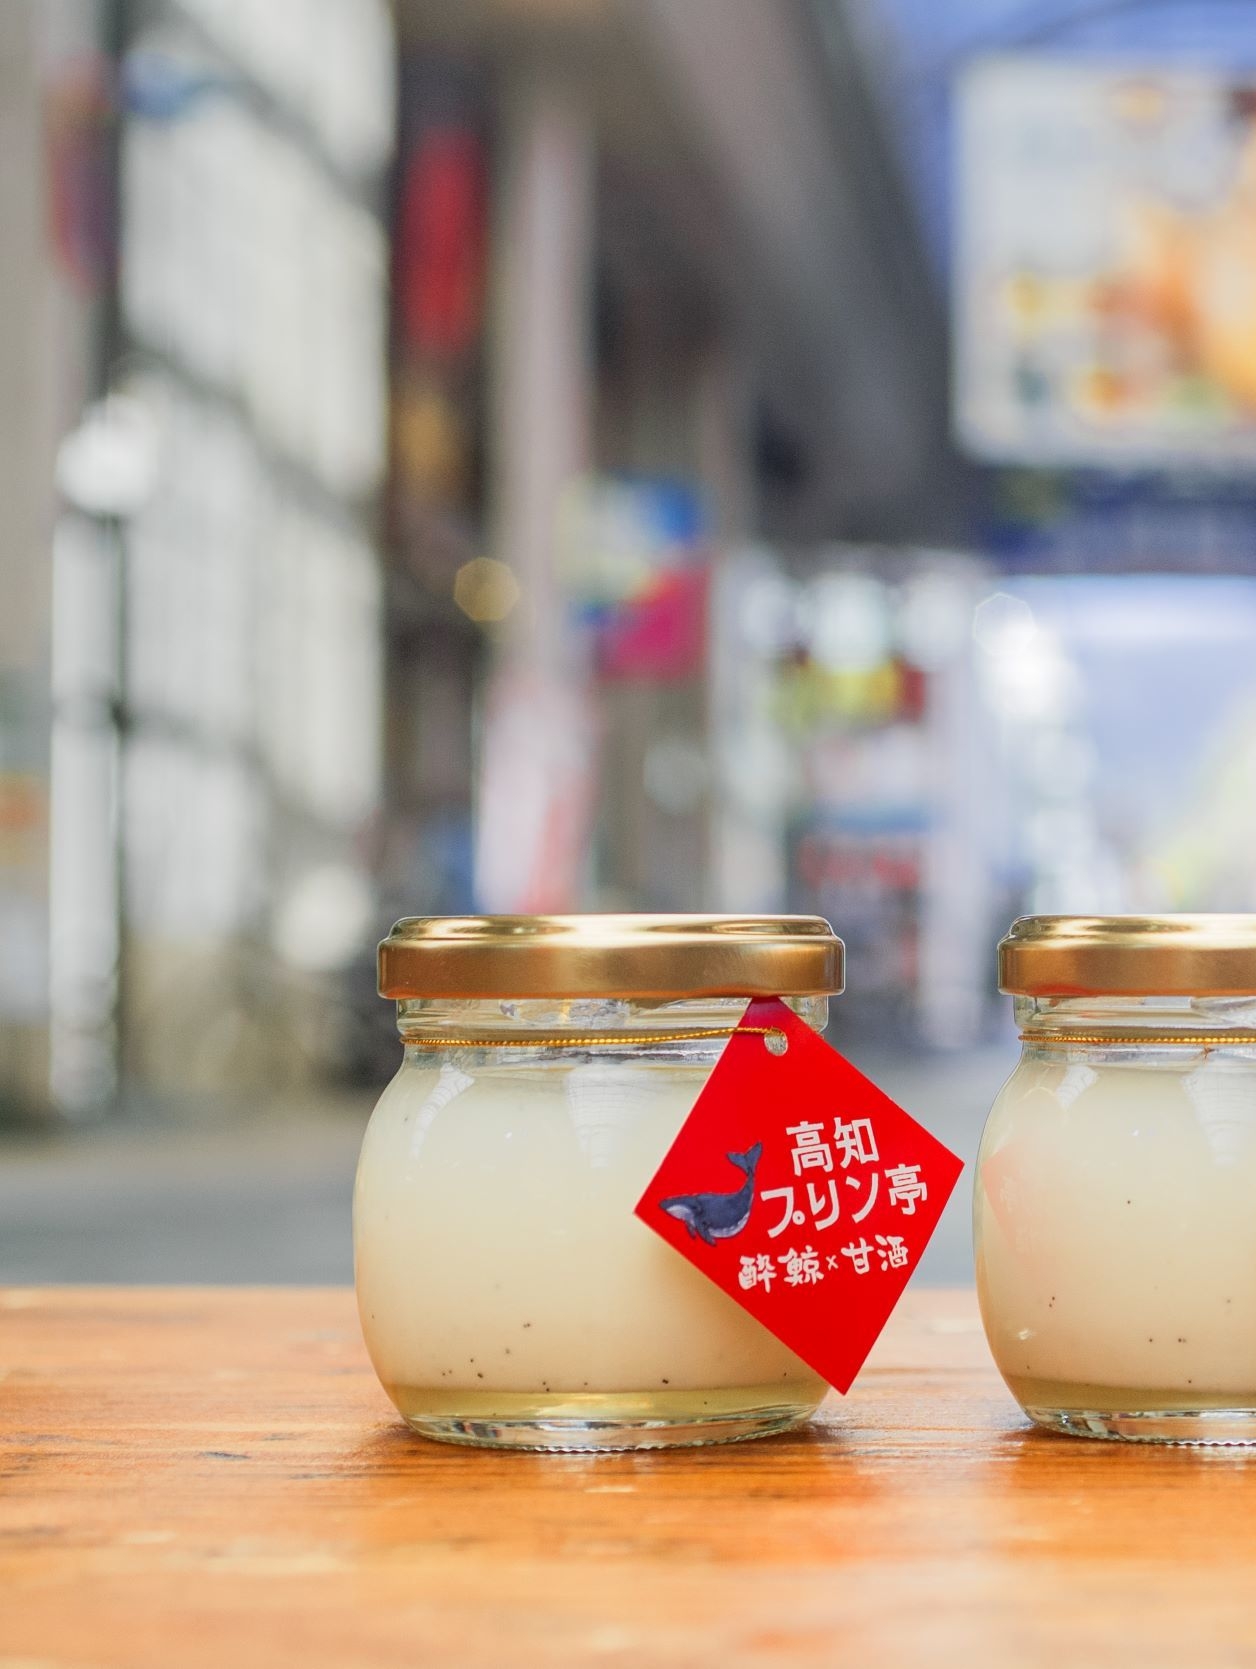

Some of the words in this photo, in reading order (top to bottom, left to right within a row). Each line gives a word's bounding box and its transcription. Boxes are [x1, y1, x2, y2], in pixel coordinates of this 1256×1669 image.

[786, 1117, 879, 1176] 高知
[760, 1163, 928, 1239] プリン亭
